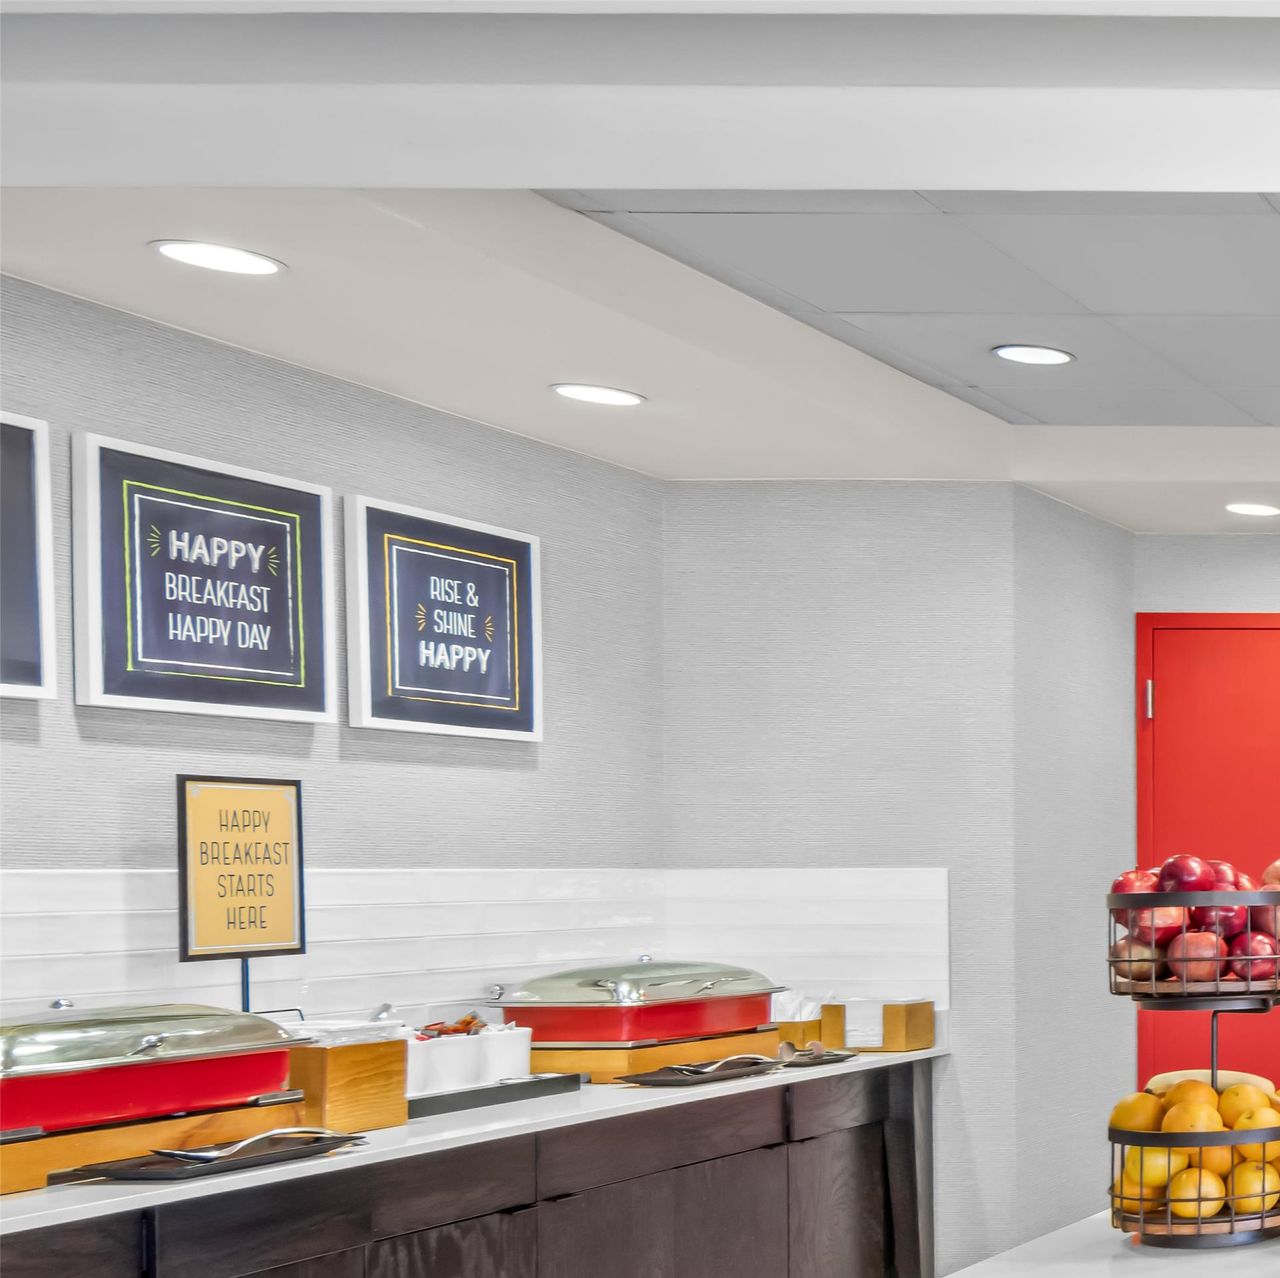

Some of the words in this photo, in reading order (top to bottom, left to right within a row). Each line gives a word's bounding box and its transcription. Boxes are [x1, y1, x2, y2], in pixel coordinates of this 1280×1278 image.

[168, 529, 266, 574] HAPPY
[164, 571, 272, 614] BREAKFAST
[429, 575, 463, 605] RISE
[466, 582, 479, 608] &
[168, 612, 232, 647] HAPPY
[237, 621, 272, 651] DAY
[433, 608, 477, 639] SHINE
[418, 640, 491, 675] HAPPY
[219, 809, 270, 833] HAPPY
[200, 841, 290, 866] BREAKFAST
[217, 874, 275, 898] STARTS
[226, 905, 268, 930] HERE
